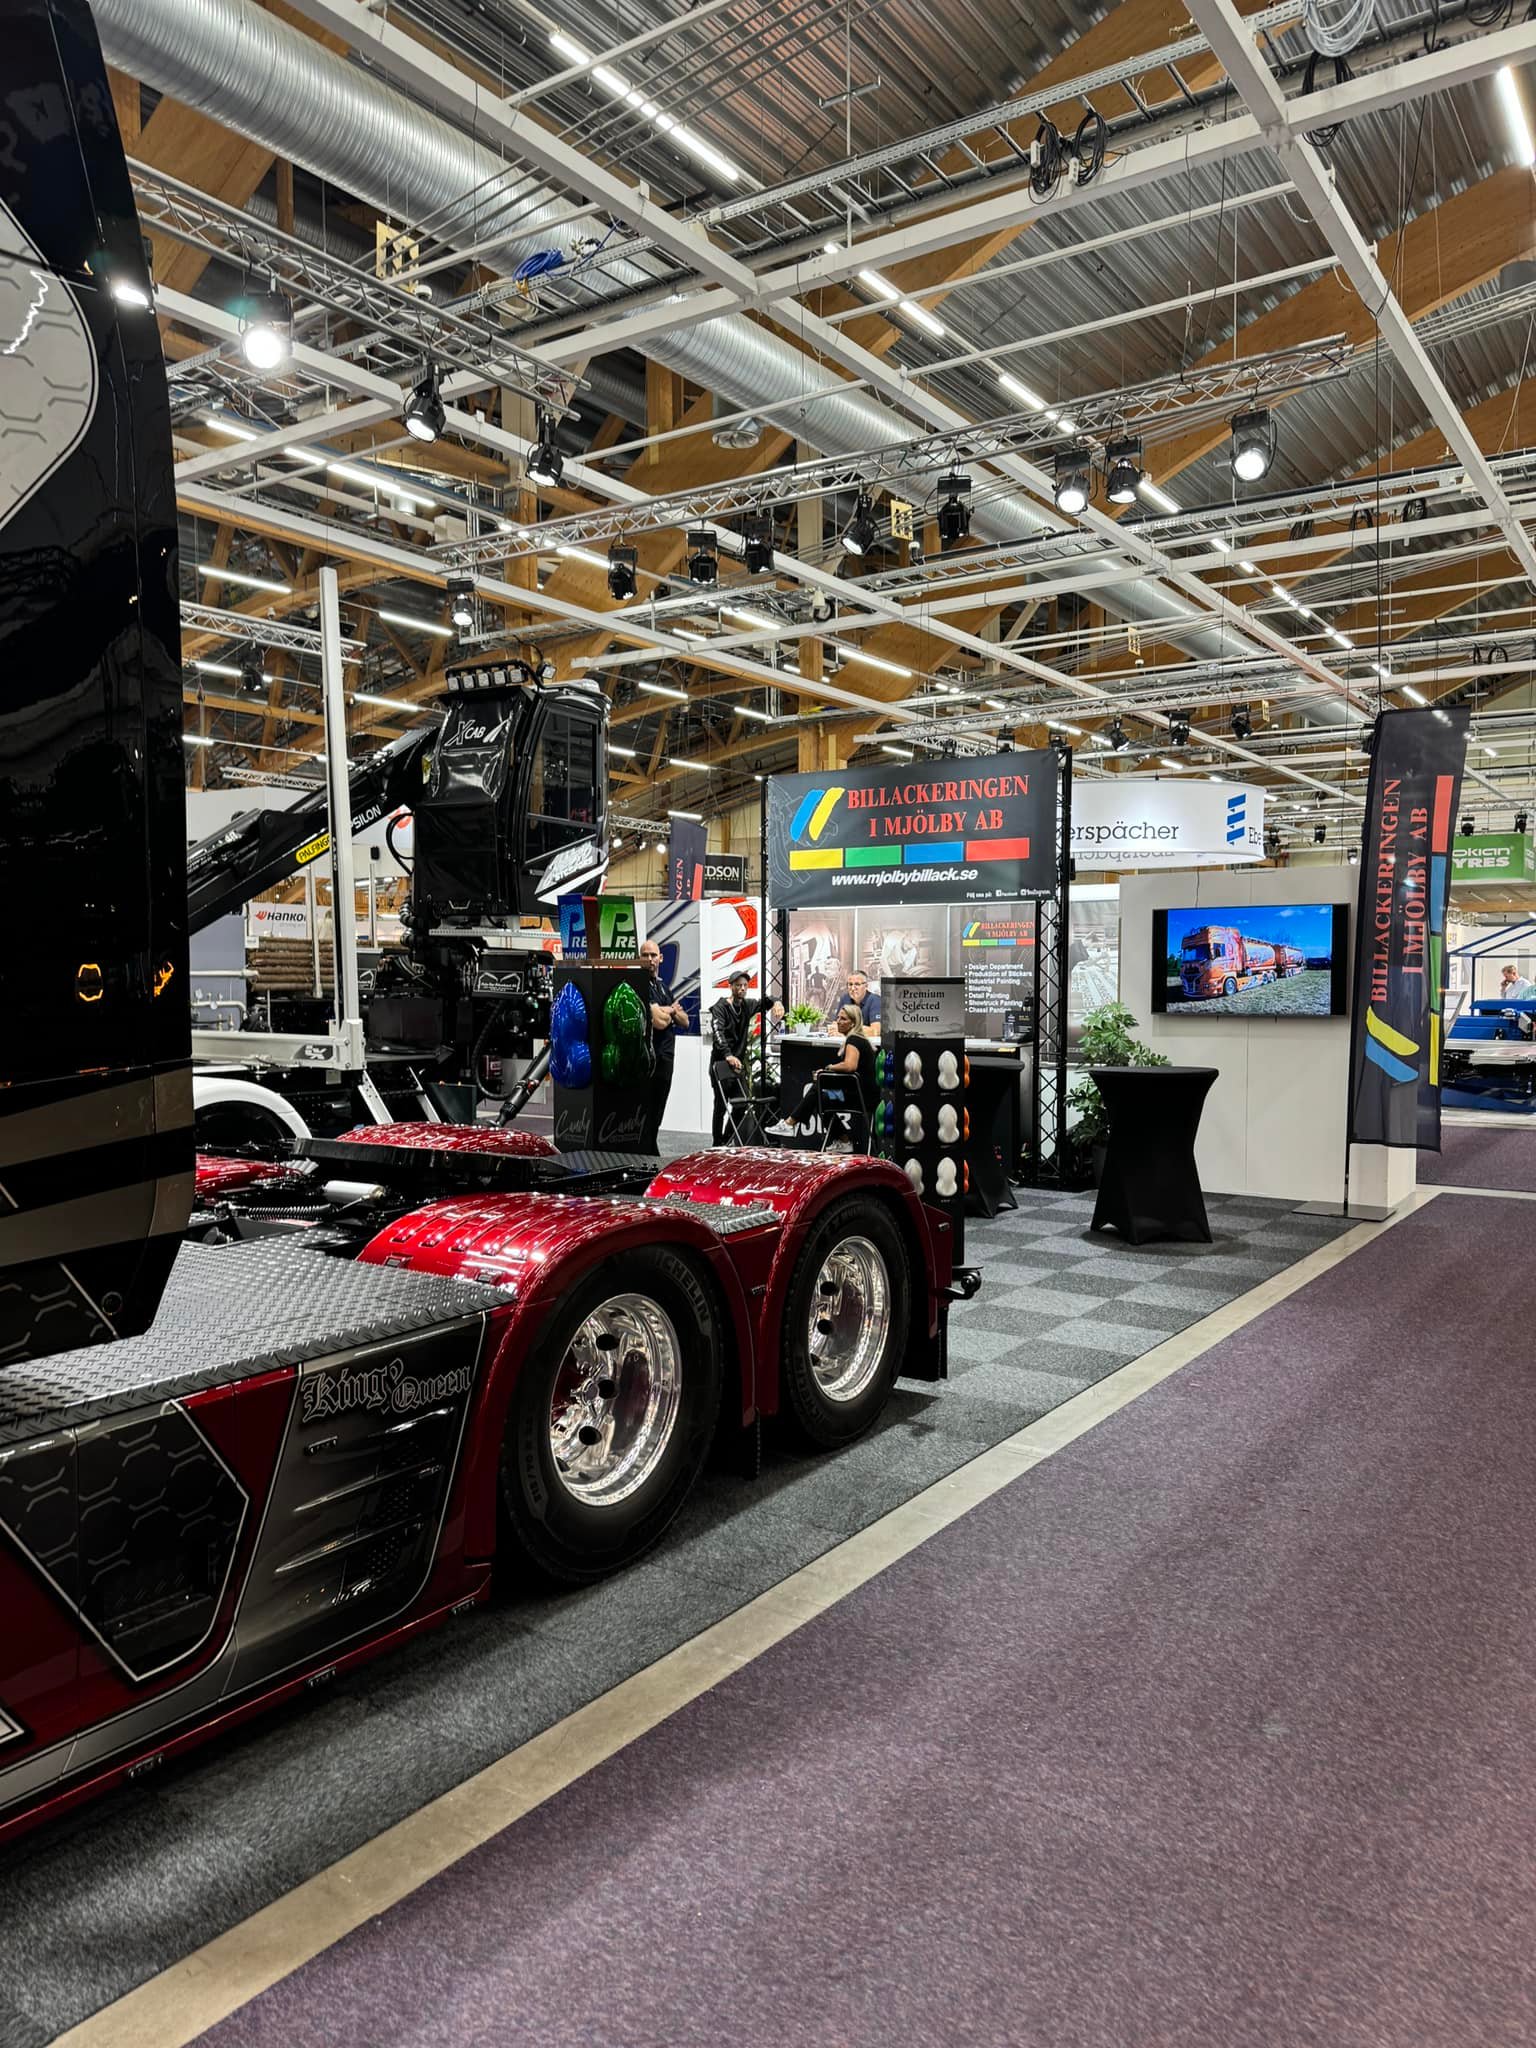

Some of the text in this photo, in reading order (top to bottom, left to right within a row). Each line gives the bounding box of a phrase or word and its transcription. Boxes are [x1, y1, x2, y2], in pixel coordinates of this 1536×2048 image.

[847, 774, 1030, 809] BILLACKERINGEN
[351, 804, 382, 829] SILON
[868, 809, 1004, 838] I MJÖLBY AB
[297, 835, 330, 861] PALFING
[1452, 856, 1510, 868] YRES
[831, 867, 979, 888] www.mjolbybillack.se
[1371, 779, 1401, 1002] BILLACKERINGEN
[1399, 806, 1428, 975] I MJÖLBY AB
[902, 989, 945, 999] Premium
[902, 1001, 940, 1010] Selected
[902, 1013, 940, 1023] Colours
[300, 1367, 388, 1423] King
[391, 1365, 472, 1414] Queen
